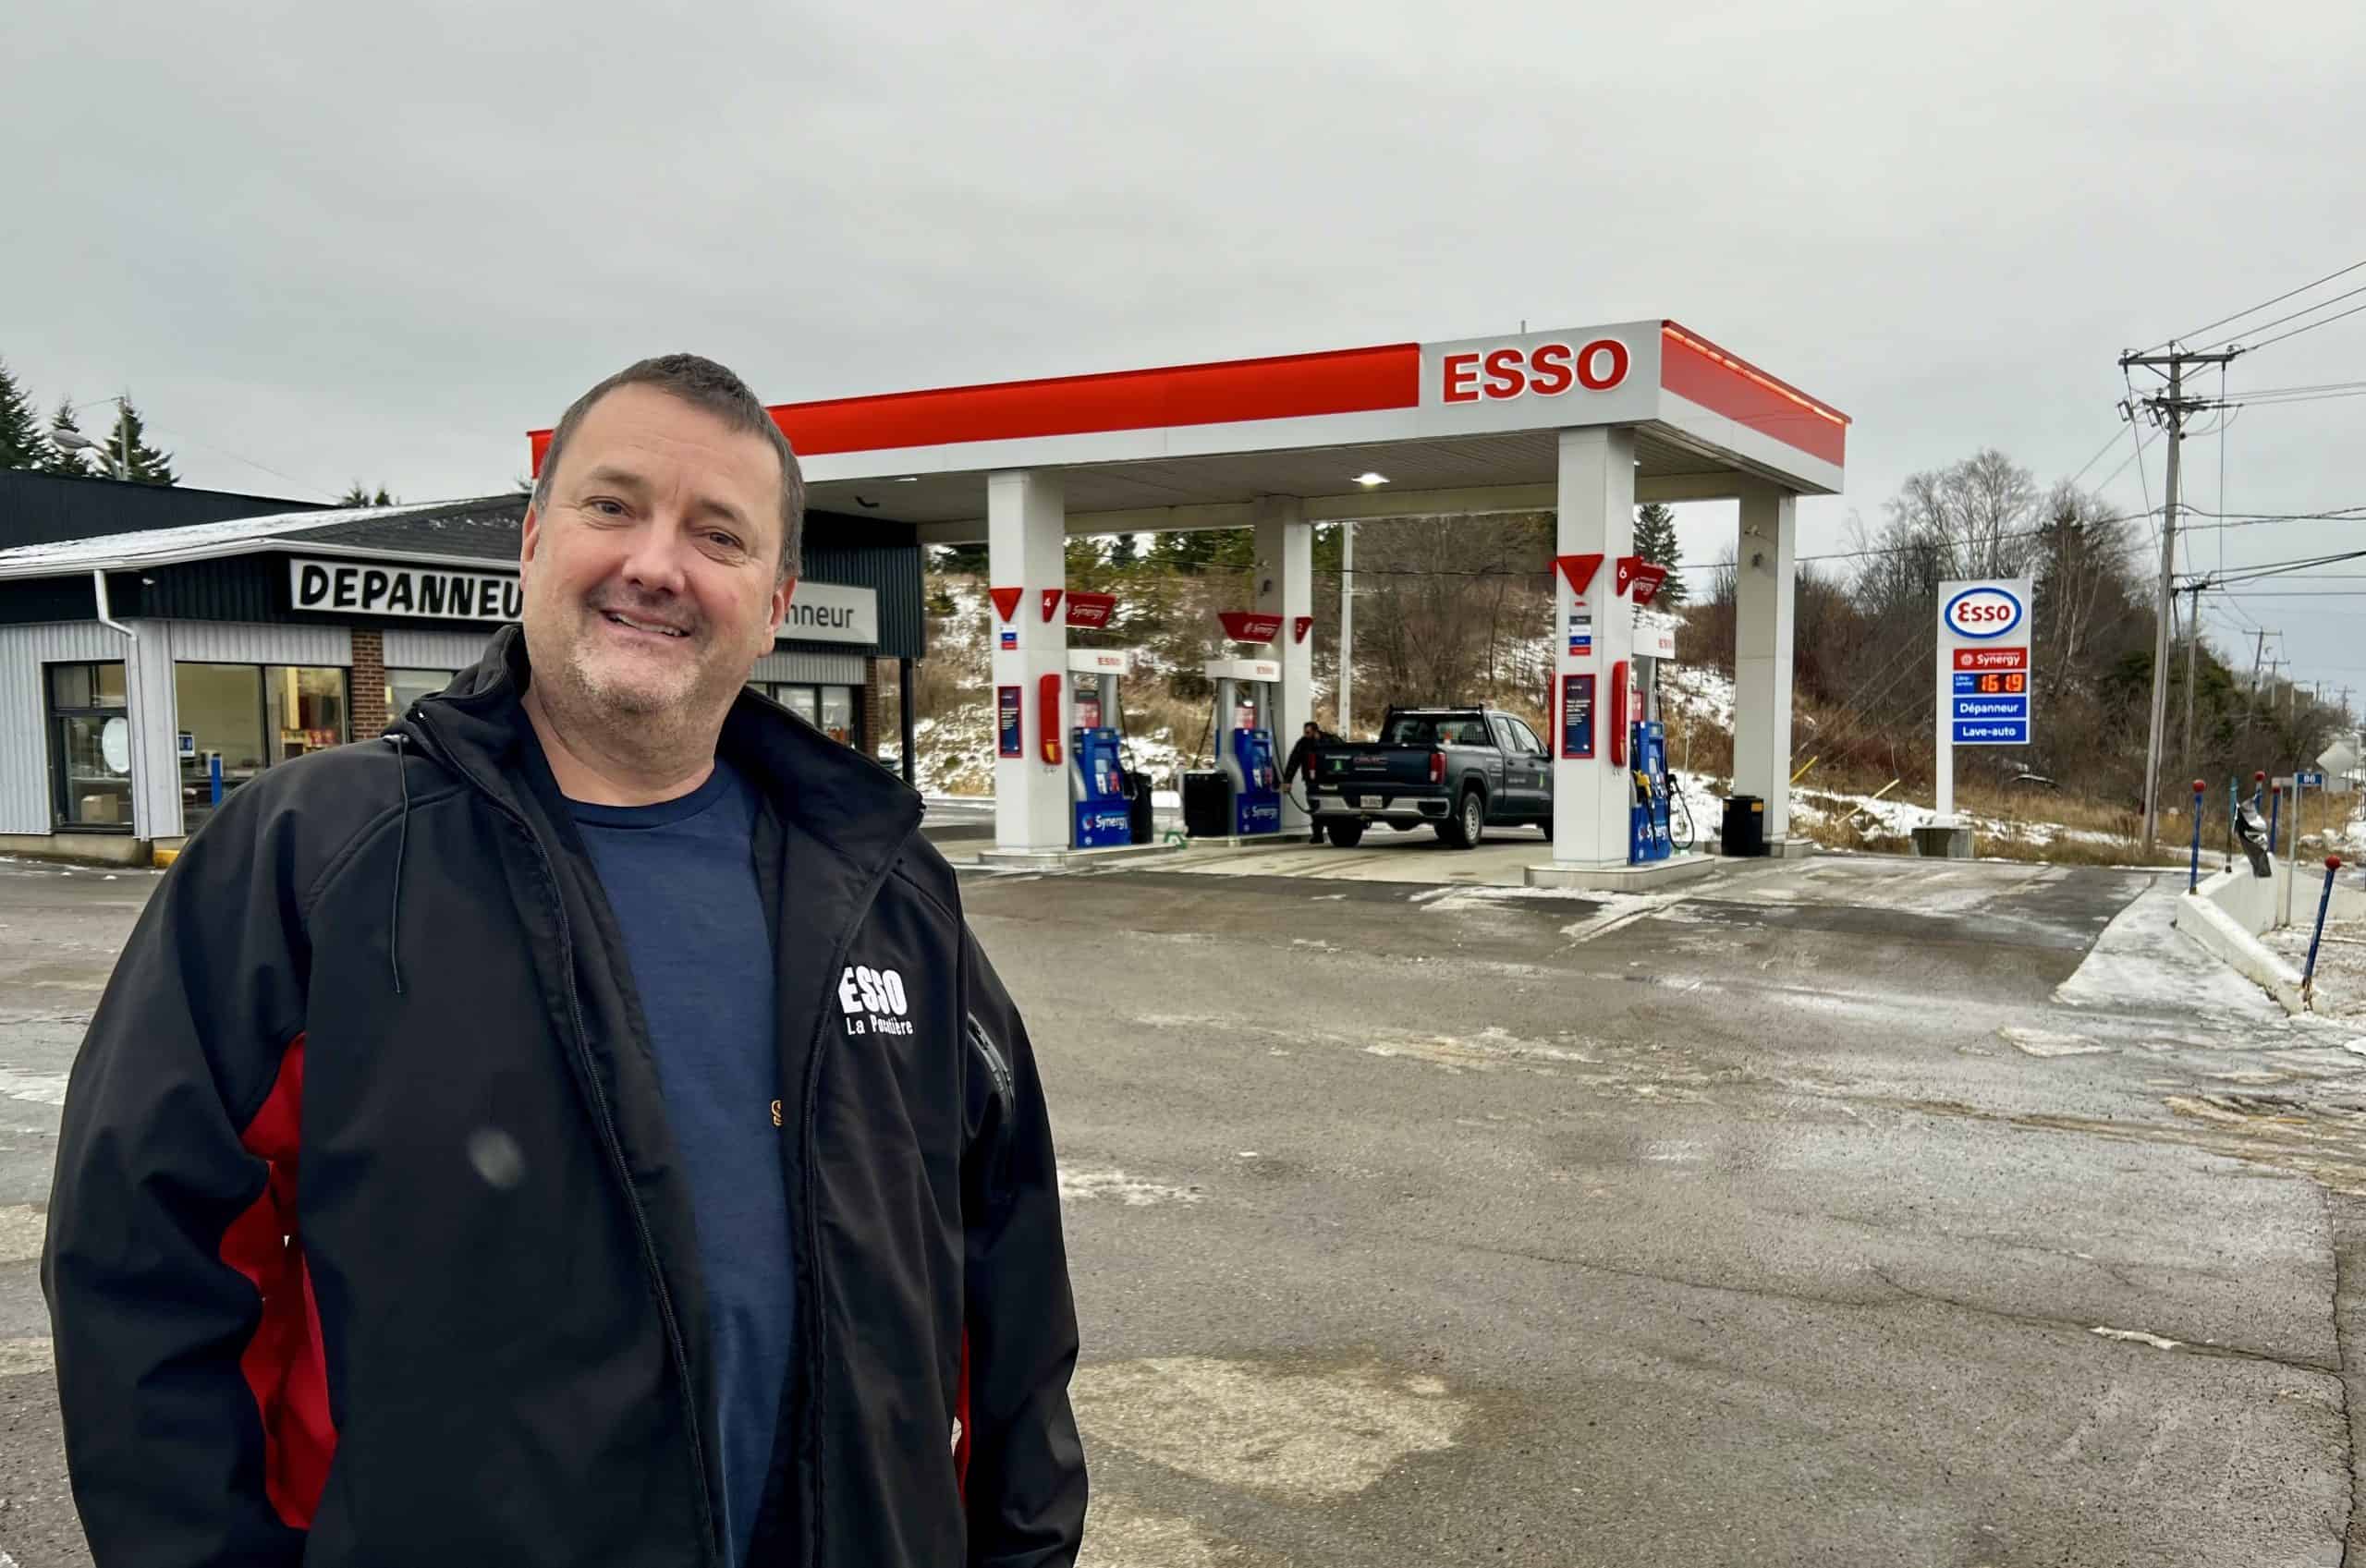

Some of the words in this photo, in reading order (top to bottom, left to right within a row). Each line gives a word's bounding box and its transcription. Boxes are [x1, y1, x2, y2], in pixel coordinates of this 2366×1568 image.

[1443, 338, 1630, 405] ESSO
[1618, 566, 1627, 579] 6
[299, 564, 523, 618] DEPANNEU
[1043, 597, 1051, 607] 4
[785, 603, 854, 629] nneur
[1957, 602, 2010, 622] Esso
[1976, 653, 2021, 666] Synergy
[1959, 702, 2018, 716] Dépanneur
[1962, 726, 2017, 737] Lave-auto
[846, 1016, 866, 1036] La
